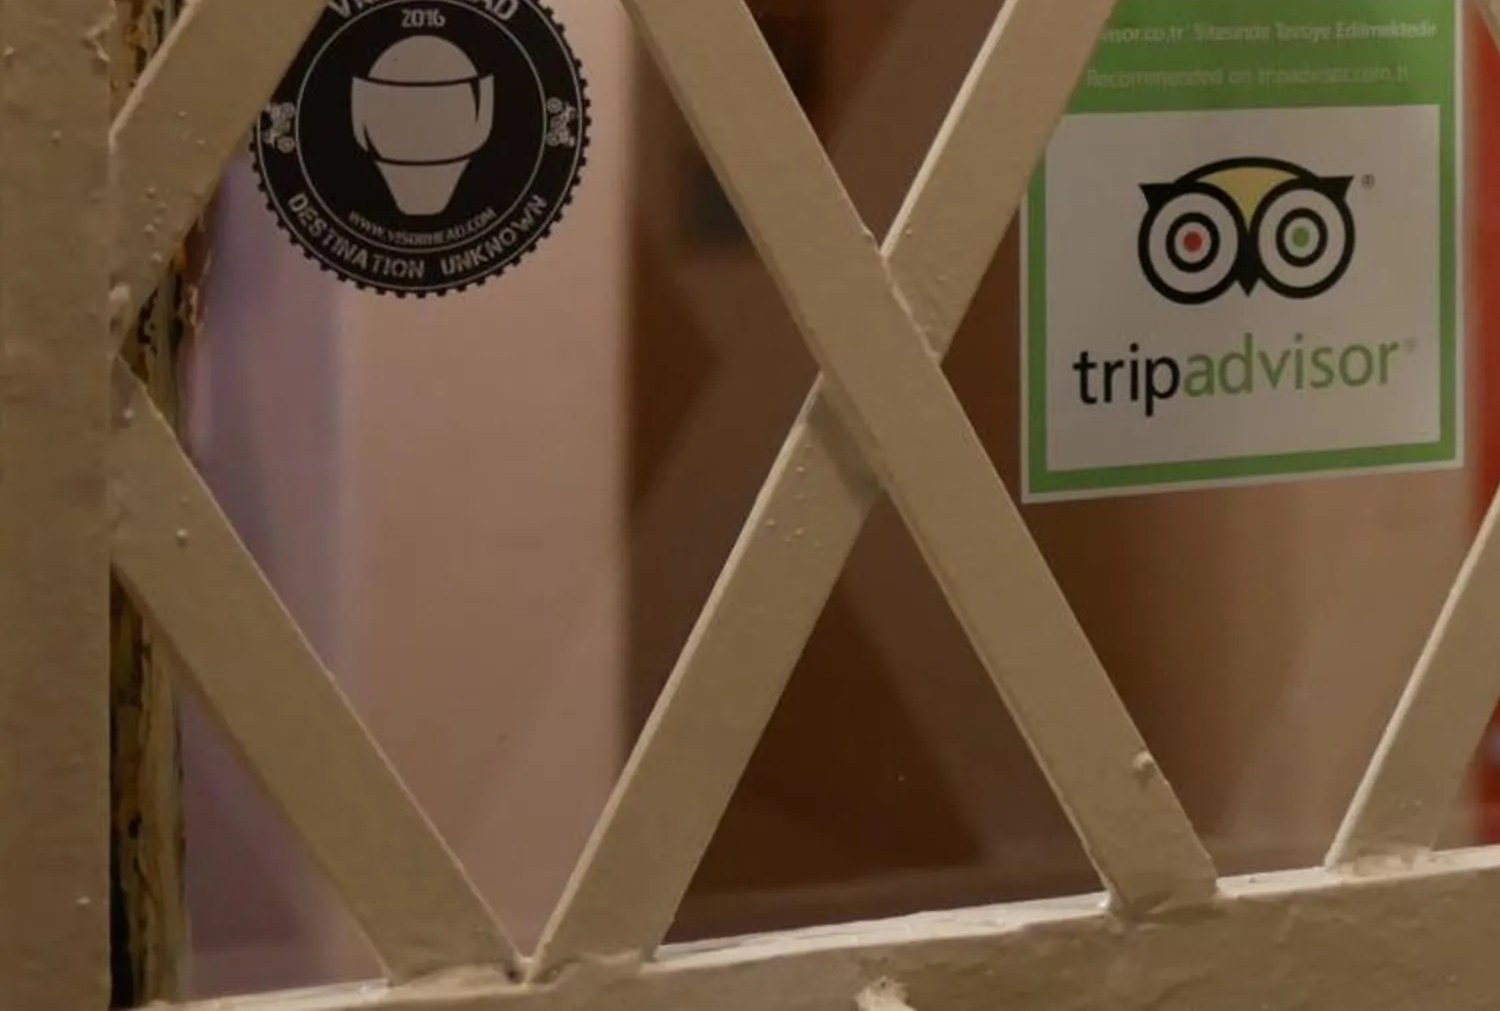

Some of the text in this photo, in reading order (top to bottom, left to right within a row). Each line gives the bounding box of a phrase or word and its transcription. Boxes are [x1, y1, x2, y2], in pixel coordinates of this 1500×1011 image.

[401, 8, 446, 29] 2016
[287, 192, 549, 279] DESTINATION UNKNOWN
[1071, 332, 1401, 418] tripadvisor
